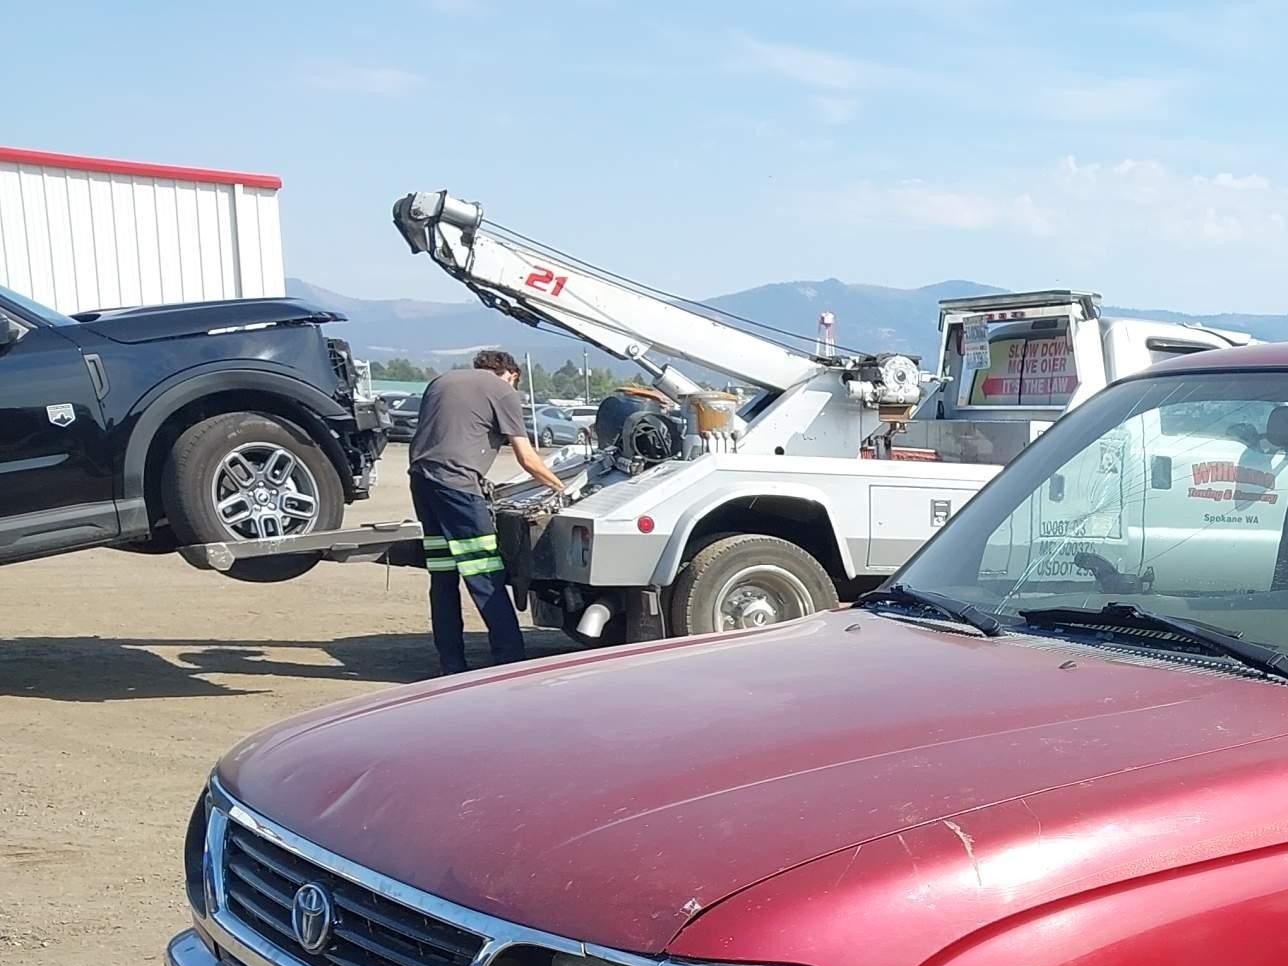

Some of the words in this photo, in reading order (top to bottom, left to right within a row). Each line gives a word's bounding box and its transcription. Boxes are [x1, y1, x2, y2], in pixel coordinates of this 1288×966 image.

[525, 265, 568, 297] 21
[1008, 343, 1040, 359] SLOW
[1007, 358, 1038, 374] MOVE
[1025, 378, 1045, 394] THE
[1047, 377, 1068, 394] LAW
[1187, 487, 1224, 502] Towing
[1203, 513, 1243, 524] Spokane
[1245, 515, 1260, 525] WA
[1037, 560, 1074, 577] USDOT
